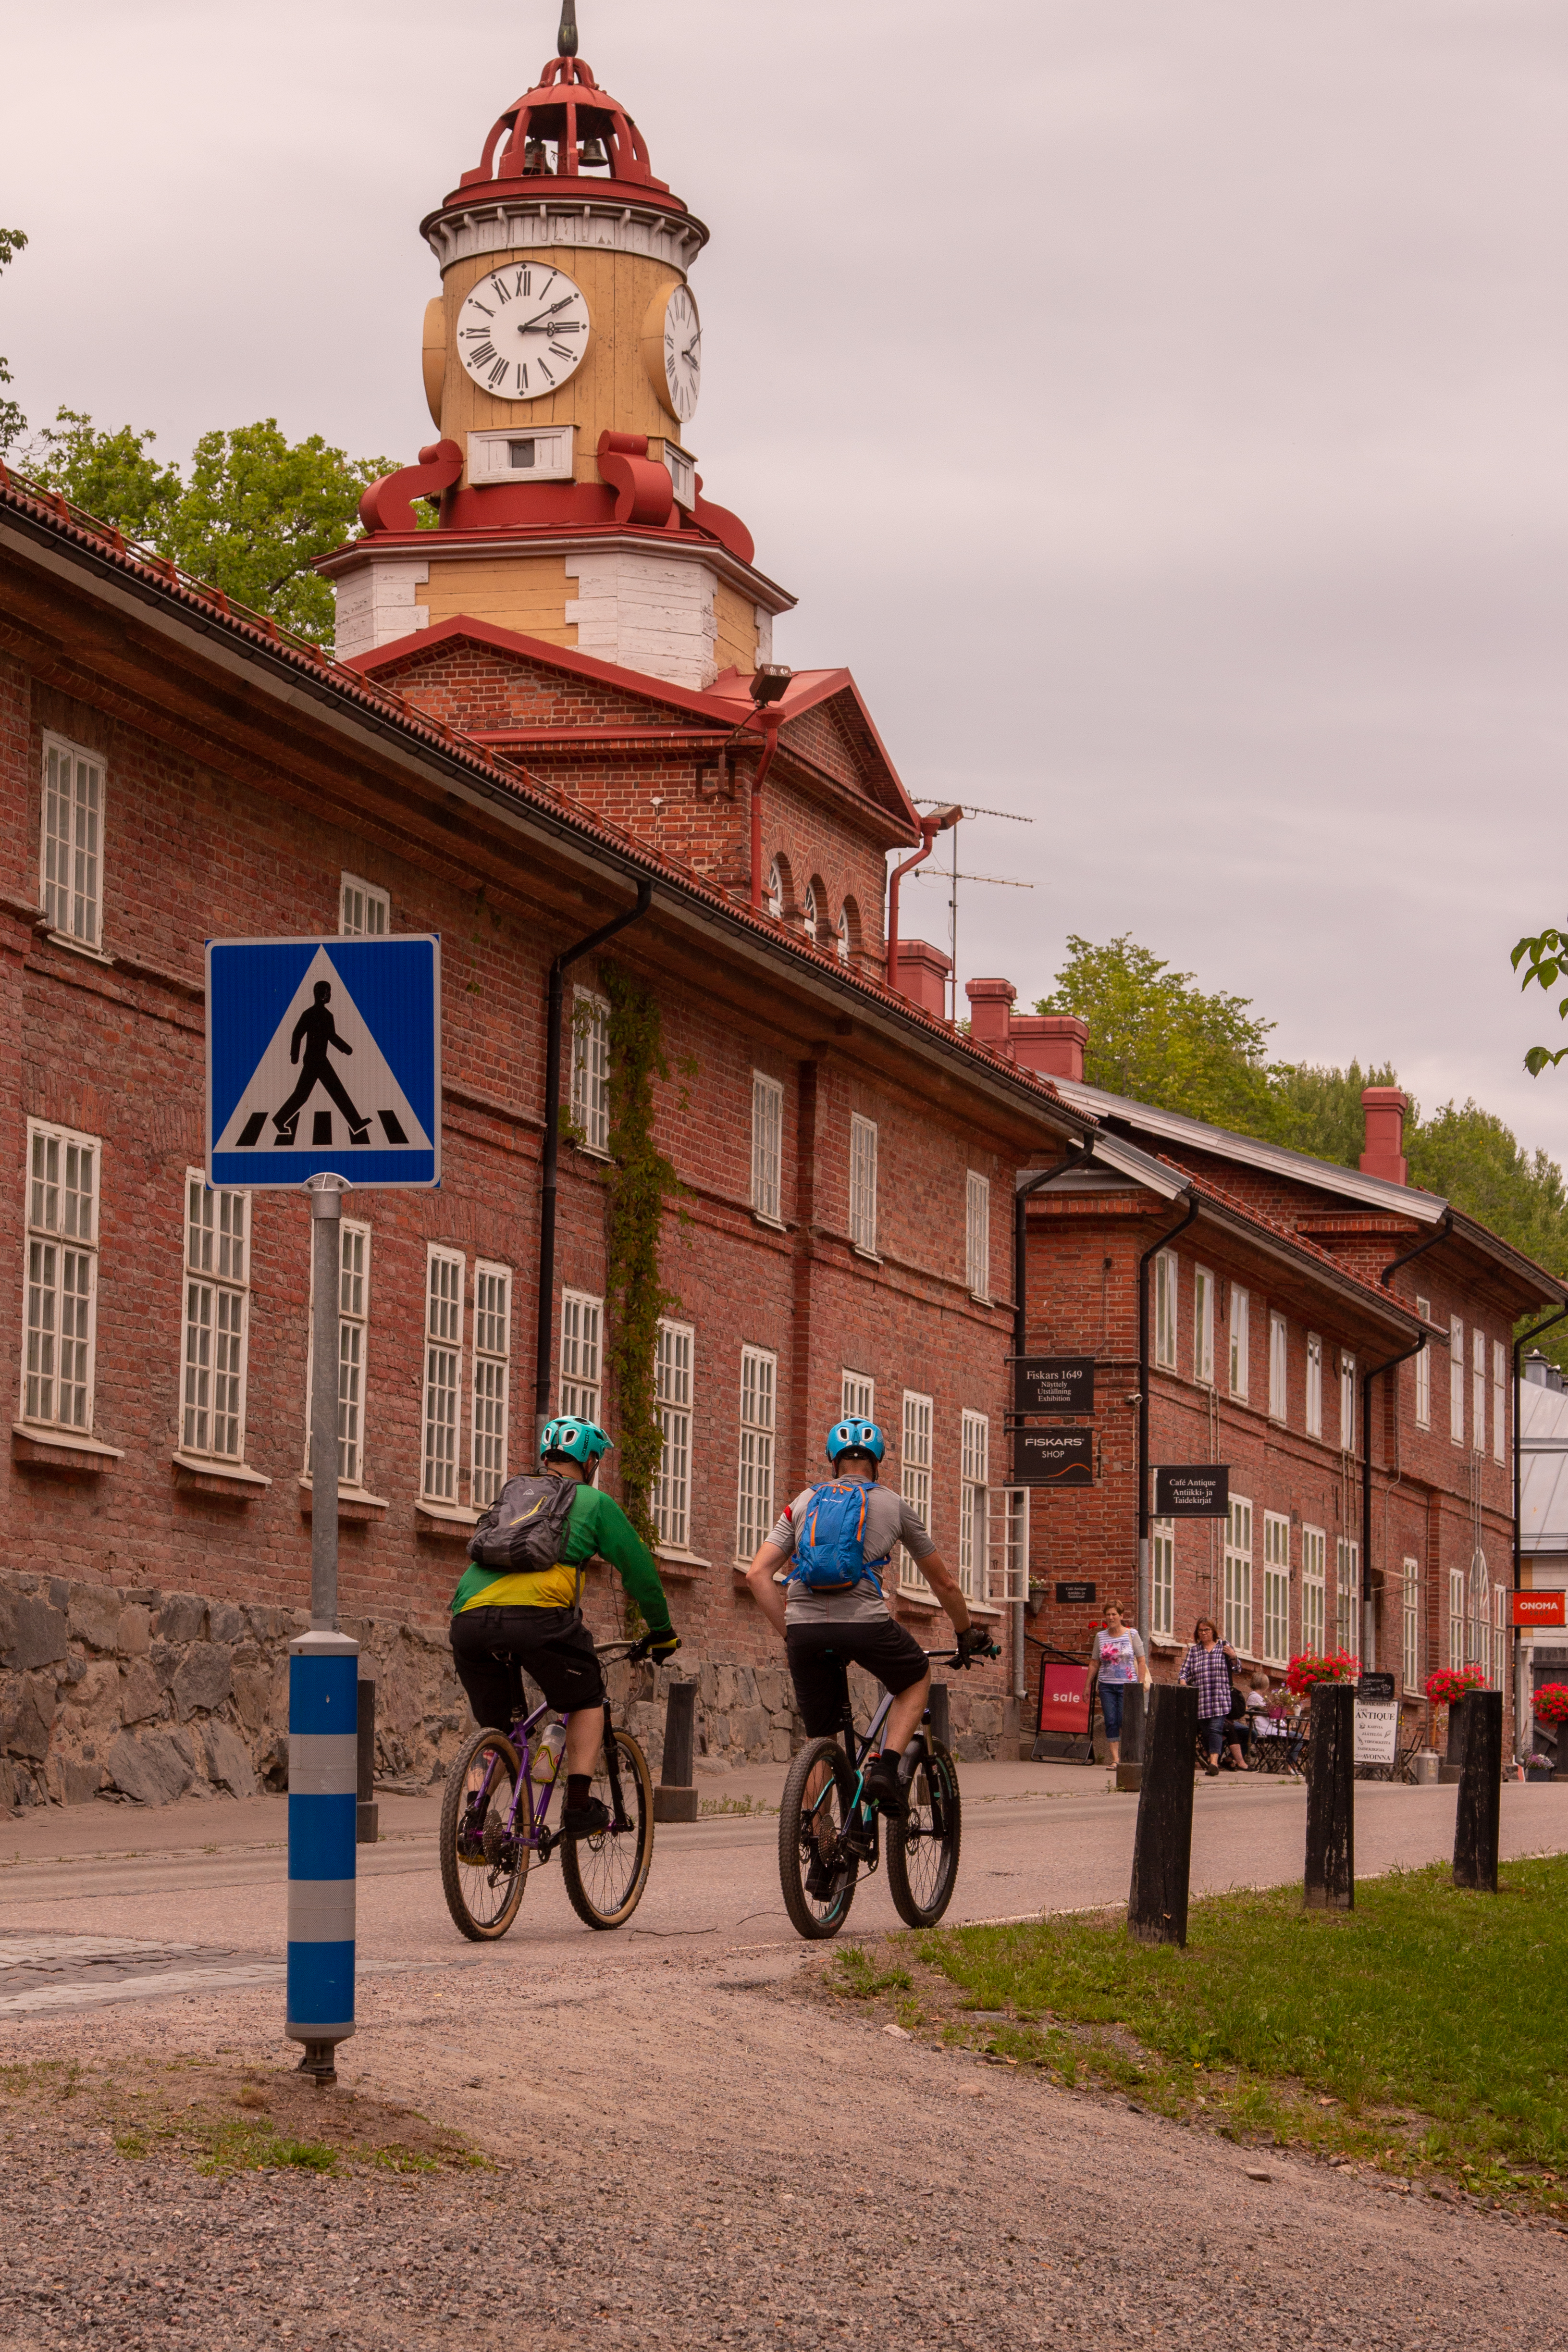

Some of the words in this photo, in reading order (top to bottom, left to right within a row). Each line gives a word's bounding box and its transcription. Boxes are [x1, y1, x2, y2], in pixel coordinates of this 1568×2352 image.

[491, 278, 511, 304] XI
[516, 271, 531, 297] XII
[539, 277, 554, 300] I
[472, 300, 496, 318] X
[466, 326, 491, 339] IX
[469, 341, 497, 370] VIII
[487, 357, 510, 385] VII
[517, 363, 529, 389] VI
[537, 357, 554, 381] V
[1026, 1371, 1059, 1380] Fiskars
[1062, 1371, 1082, 1379] 1649
[1187, 1479, 1216, 1487] Antique
[1173, 1497, 1211, 1505] Taidekirjat
[1206, 1489, 1213, 1497] ja
[1053, 1692, 1080, 1703] sale
[1356, 1712, 1395, 1721] ANTIQUE
